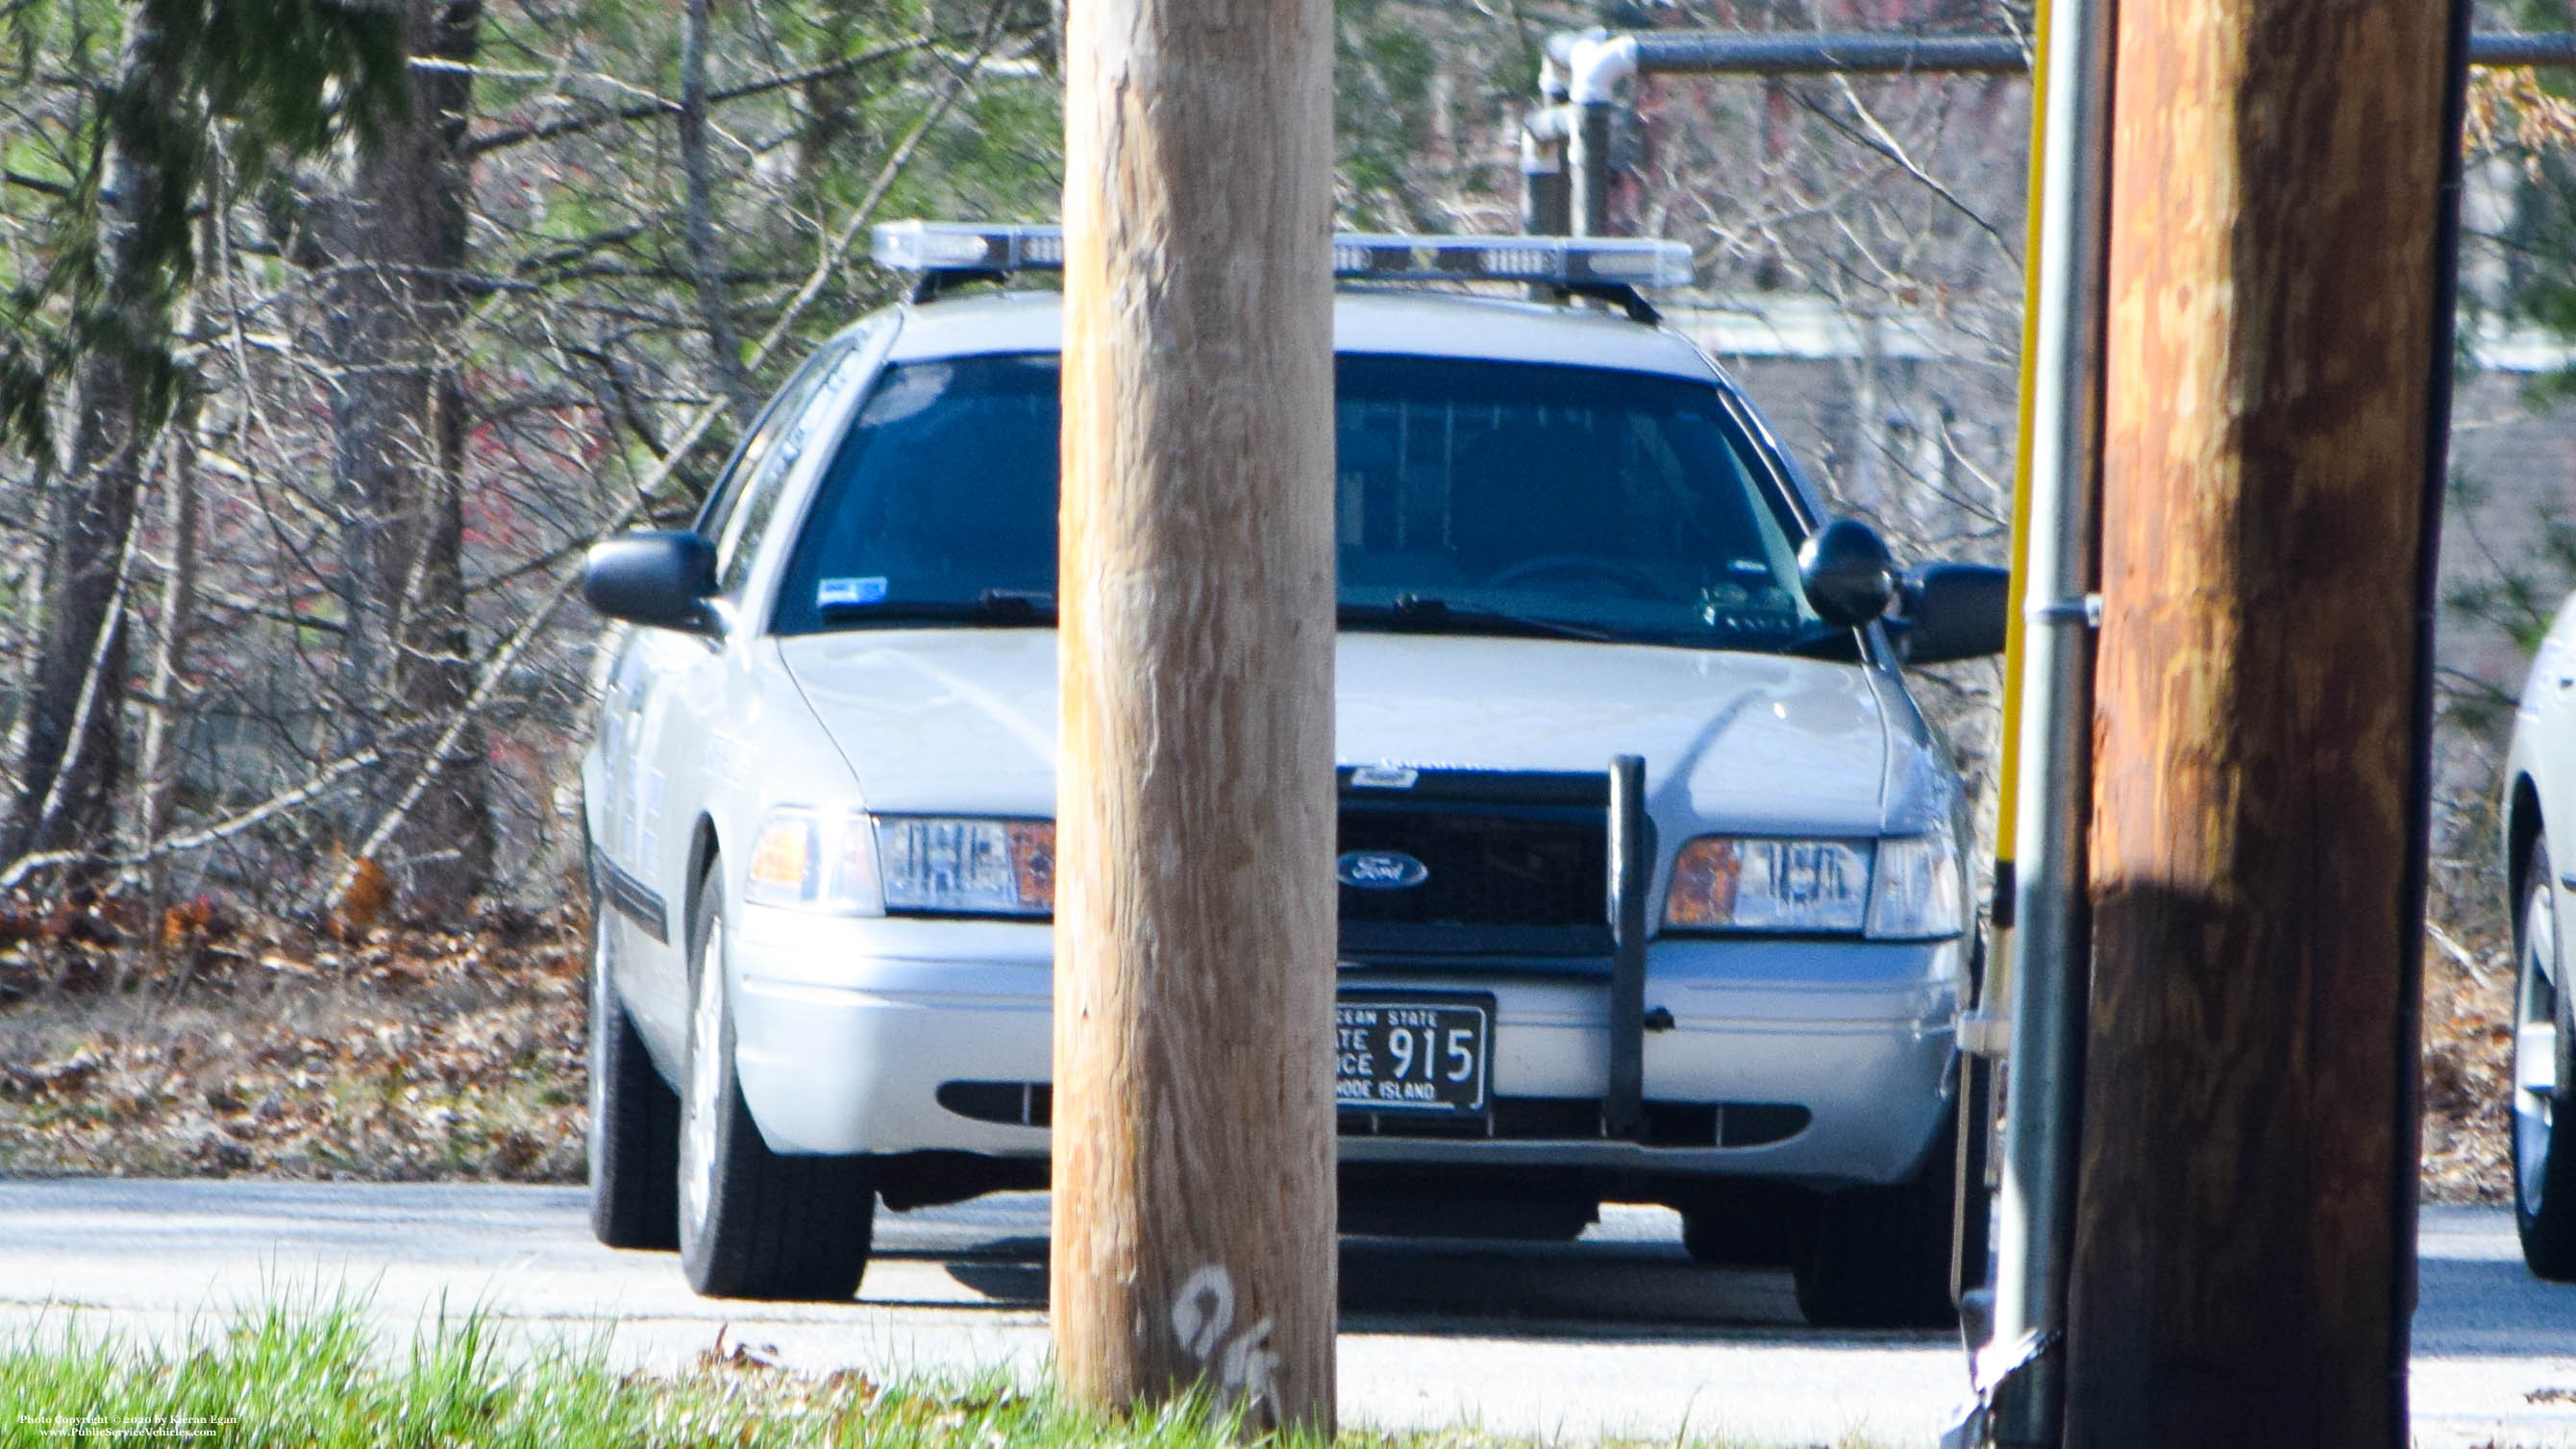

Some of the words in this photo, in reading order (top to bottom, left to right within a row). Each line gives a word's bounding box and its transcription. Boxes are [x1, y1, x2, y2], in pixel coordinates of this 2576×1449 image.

[1352, 856, 1403, 881] Ford
[1336, 1009, 1377, 1025] CEAN
[1388, 1010, 1439, 1027] STATE
[1336, 1027, 1369, 1050] TE
[1388, 1027, 1474, 1083] 915
[1378, 1081, 1437, 1101] ISLAND
